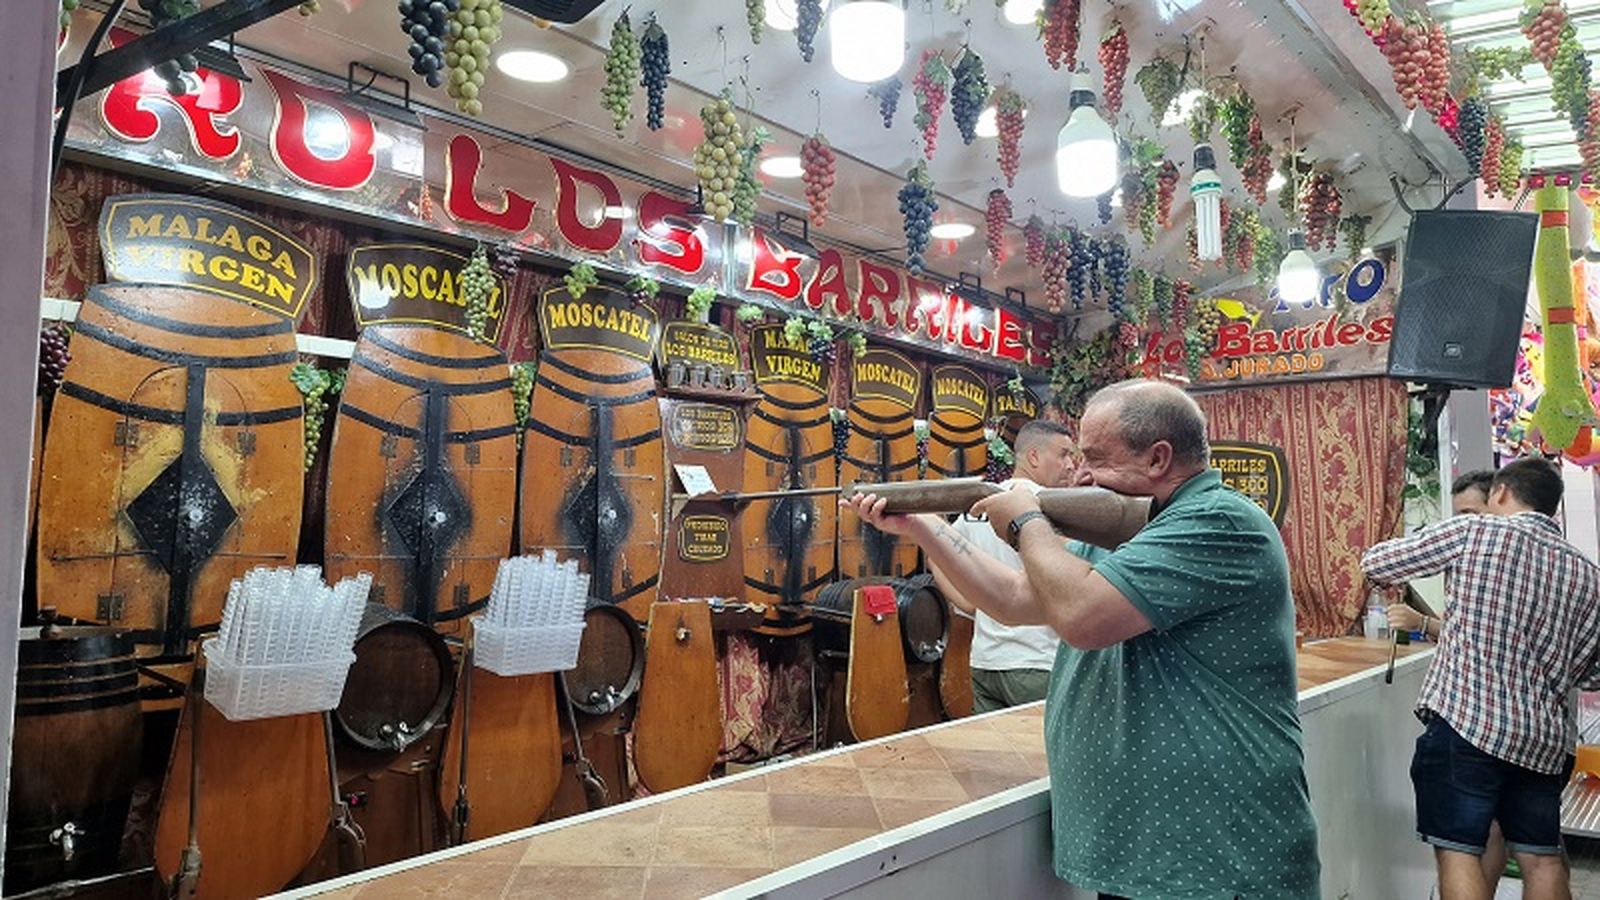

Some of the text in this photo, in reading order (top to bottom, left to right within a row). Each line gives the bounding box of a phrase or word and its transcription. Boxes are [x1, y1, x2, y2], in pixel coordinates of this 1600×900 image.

[127, 214, 297, 279] MALAGA
[445, 134, 704, 274] LOS
[748, 226, 1057, 367] BARRILES
[126, 246, 295, 304] VIRGEN
[354, 264, 501, 319] MOSCATL
[548, 303, 651, 342] MOSCATEL
[1211, 312, 1395, 359] Barriles
[666, 342, 736, 365] LOS BARRILES
[766, 355, 821, 381] VIRGEN
[857, 363, 915, 395] MOSCATEL
[937, 379, 985, 406] MOSCATEL
[1210, 458, 1267, 473] ARRILES
